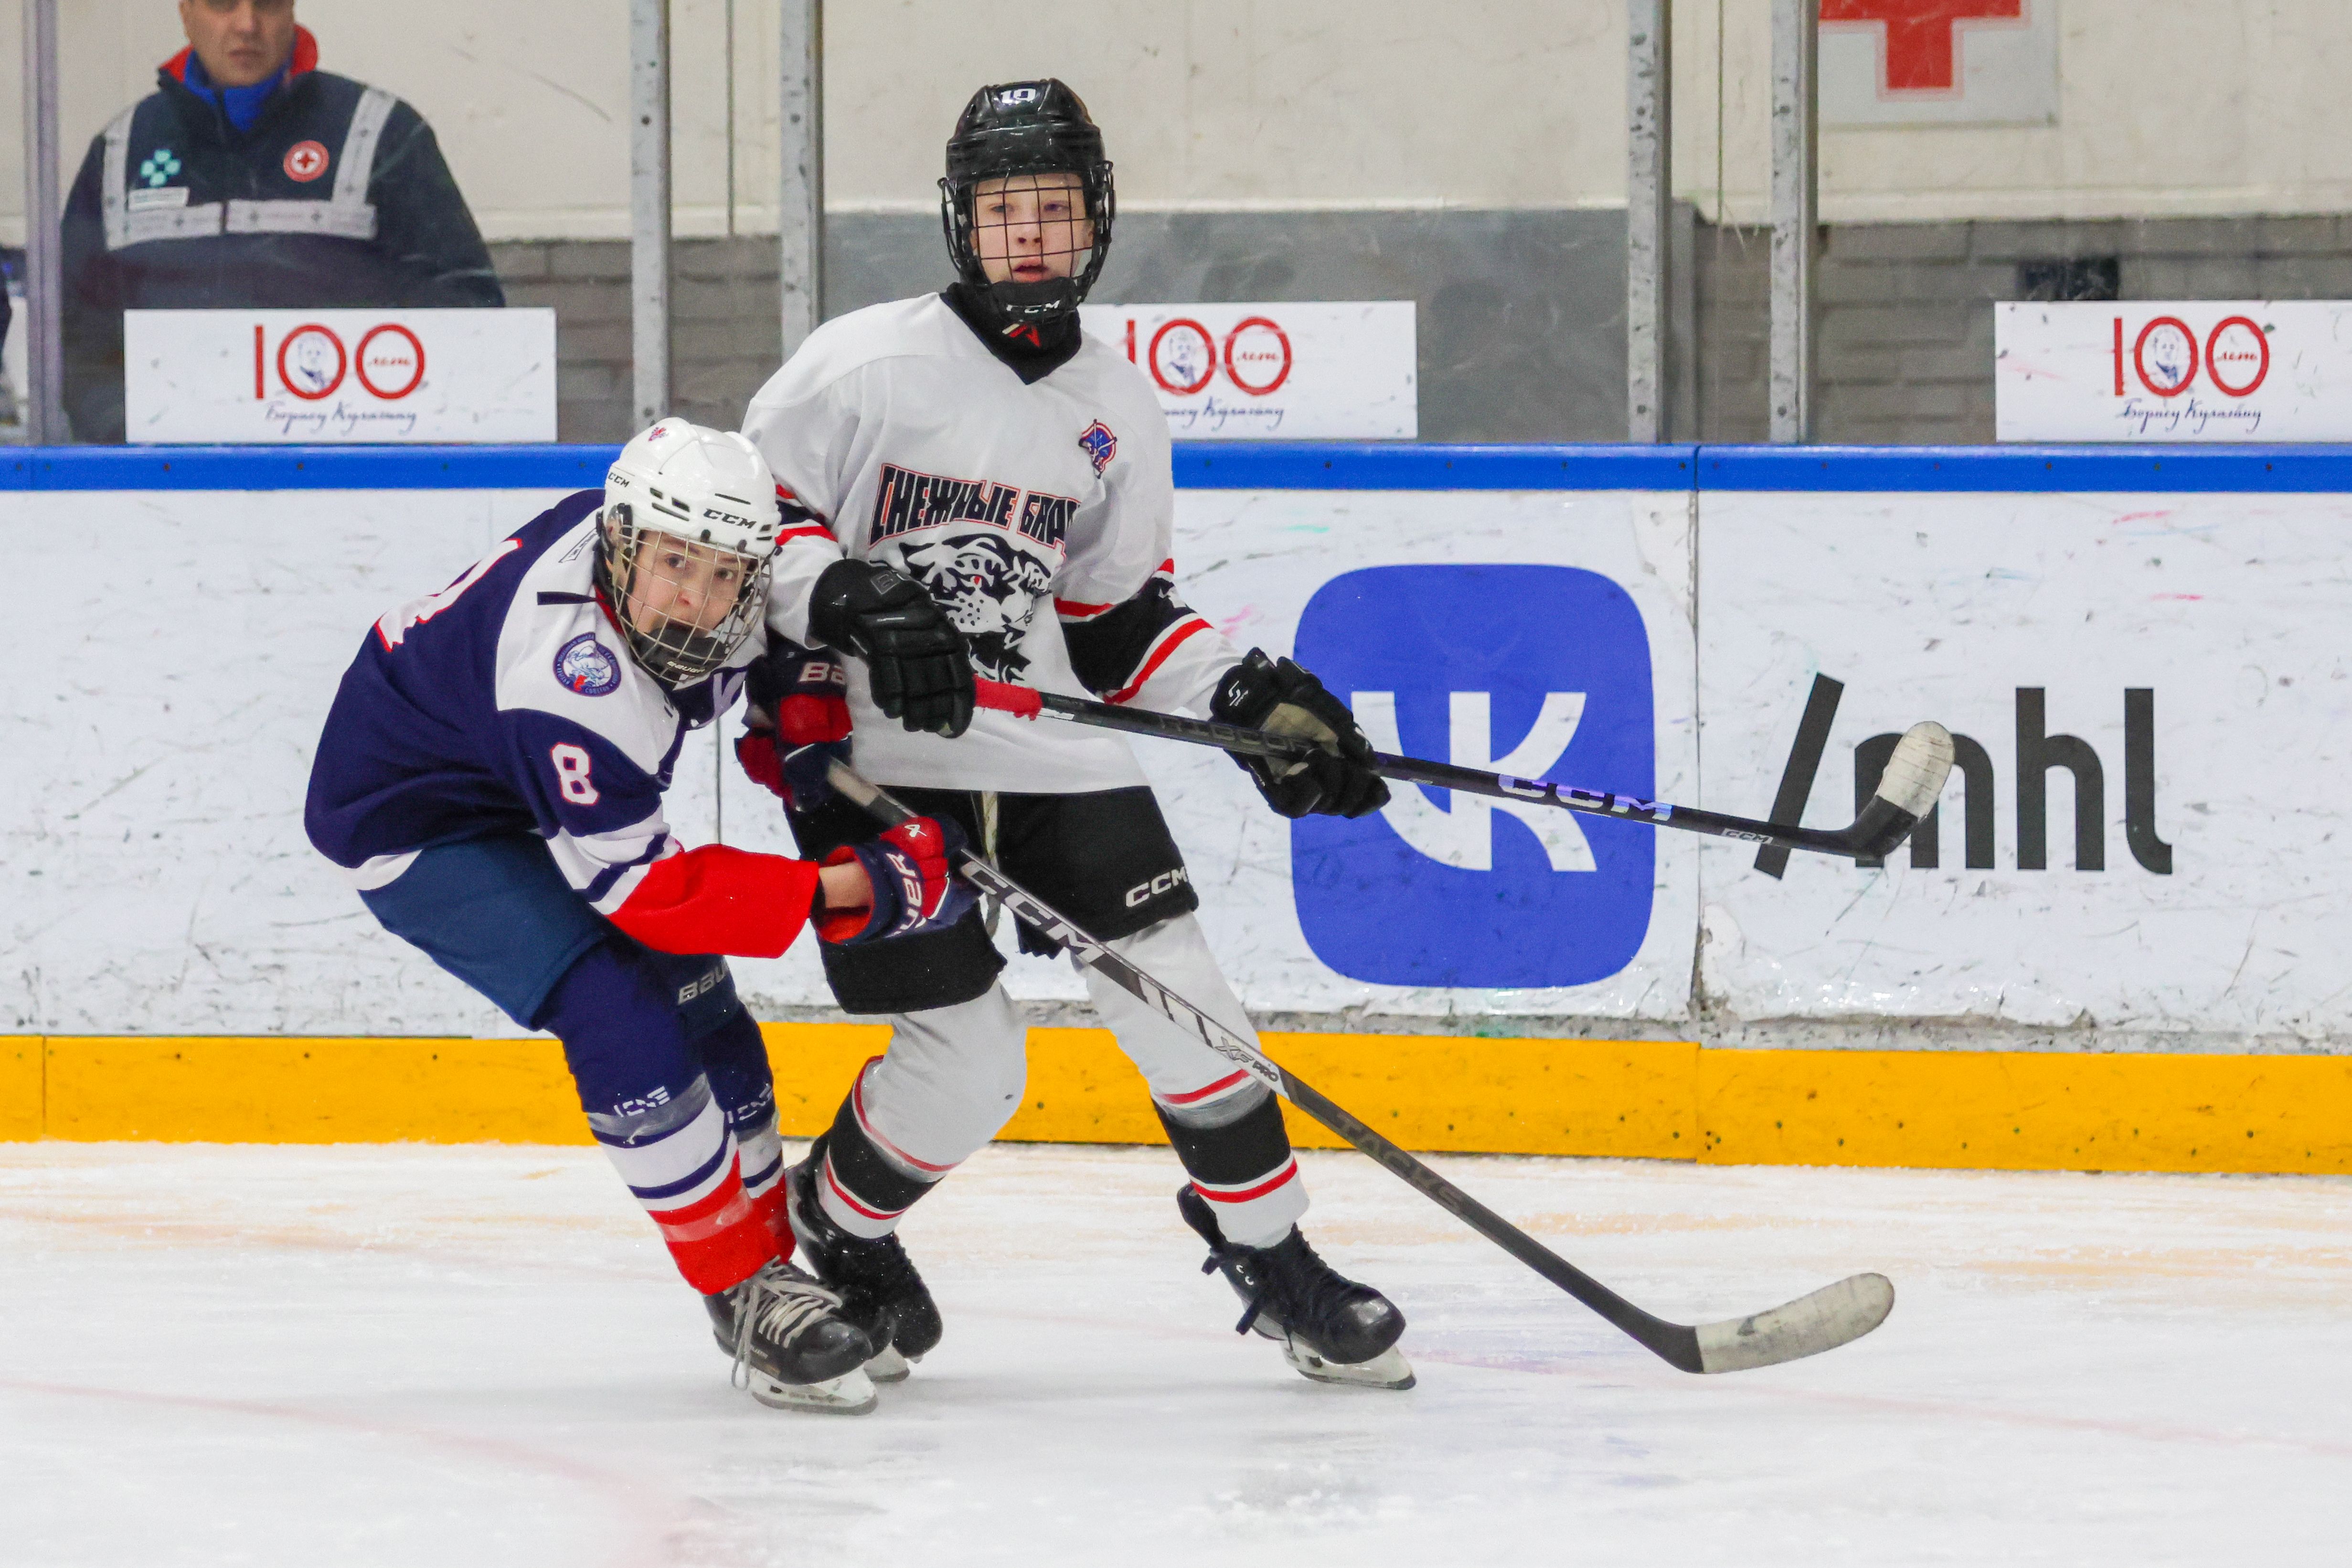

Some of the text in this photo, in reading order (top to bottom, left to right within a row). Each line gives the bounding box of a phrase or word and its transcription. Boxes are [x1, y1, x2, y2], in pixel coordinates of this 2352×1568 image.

[255, 322, 425, 400] 100
[1126, 316, 1292, 396] 100
[2114, 316, 2269, 397] 100
[607, 472, 629, 488] CCM
[867, 463, 1021, 550] СНЕЖНЫЕ
[703, 508, 756, 530] CCM
[549, 742, 600, 804] 8
[1498, 774, 1672, 821] CCM
[1725, 830, 1771, 843] CCM
[1125, 866, 1189, 907] CCM
[678, 961, 726, 1006] BAU
[959, 860, 1107, 964] CCM
[1252, 1060, 1279, 1082] PRO
